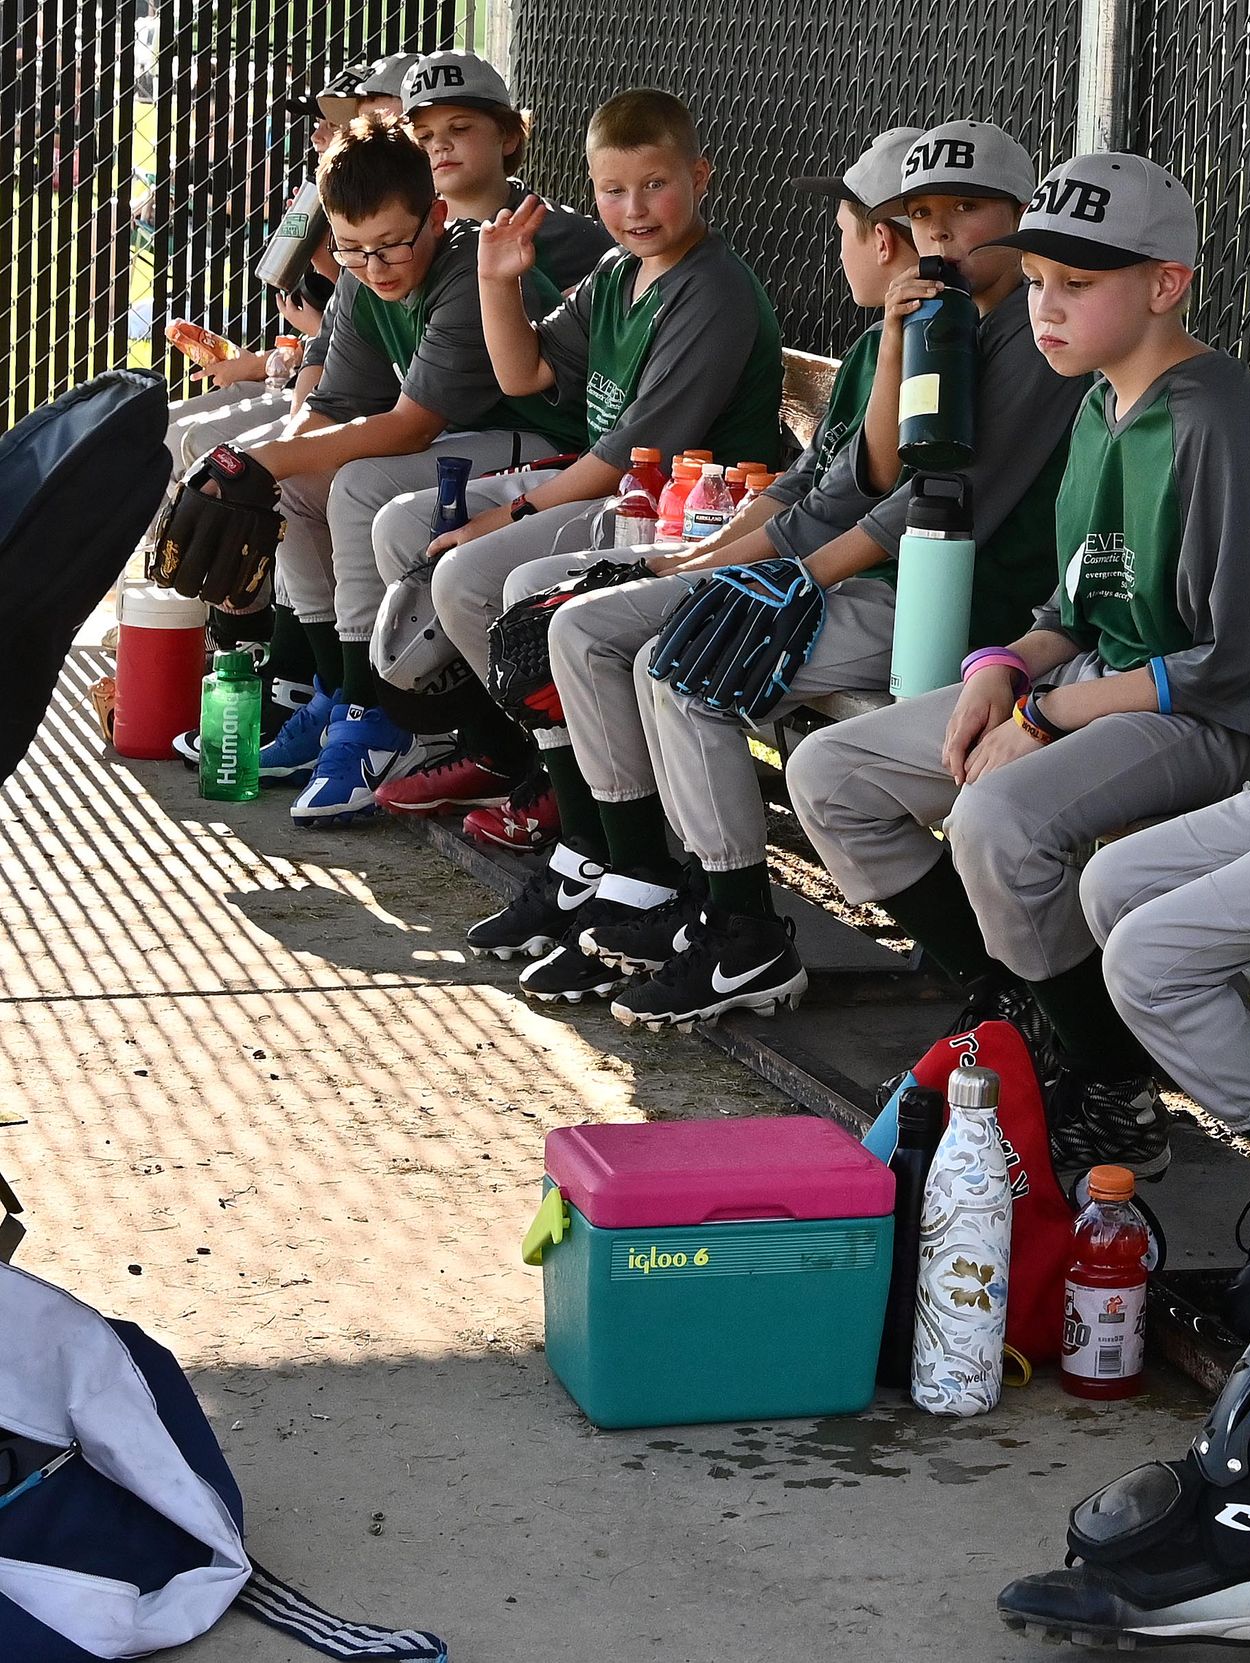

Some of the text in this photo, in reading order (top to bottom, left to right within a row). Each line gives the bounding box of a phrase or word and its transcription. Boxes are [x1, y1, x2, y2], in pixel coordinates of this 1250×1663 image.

[905, 139, 975, 179] SVB
[1026, 178, 1111, 223] SVB
[628, 1246, 710, 1274] igloo 6
